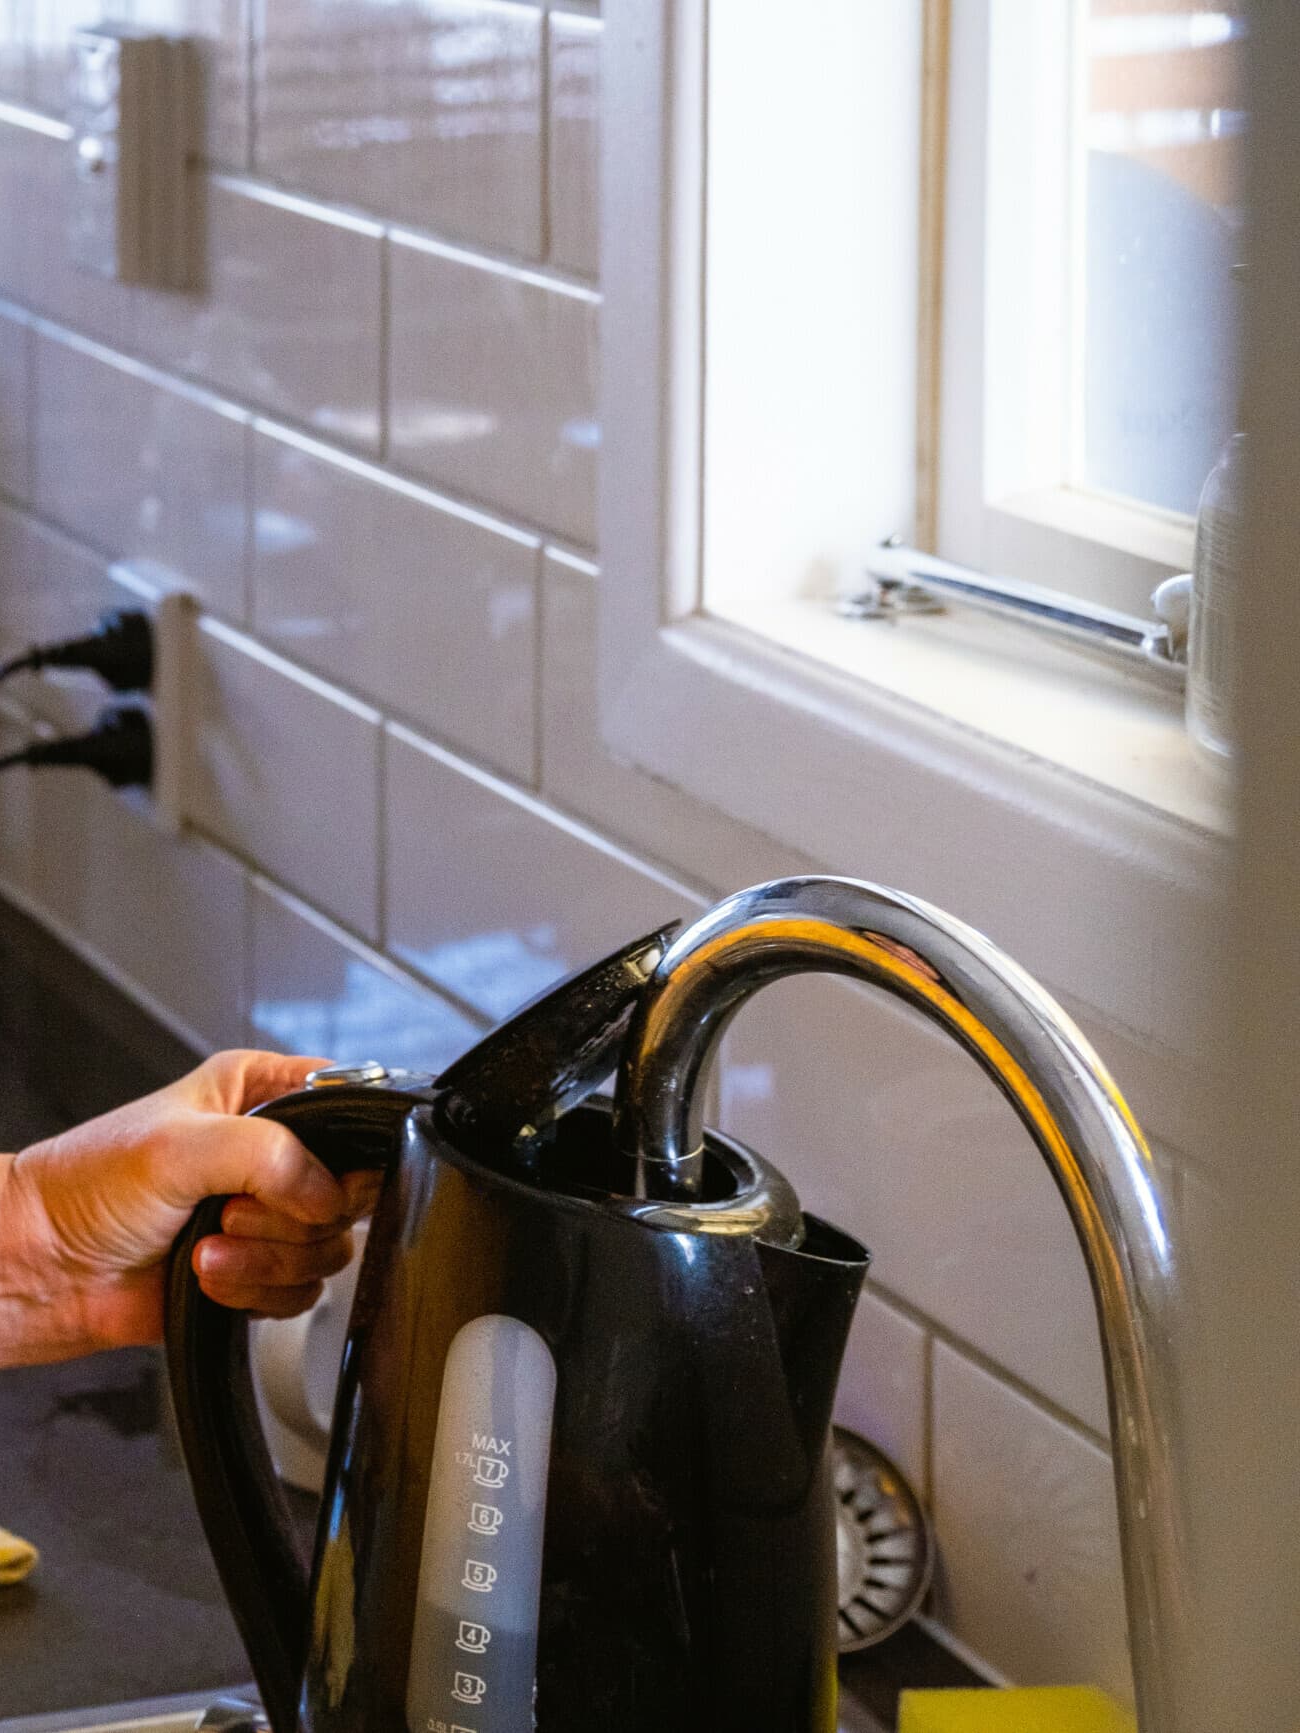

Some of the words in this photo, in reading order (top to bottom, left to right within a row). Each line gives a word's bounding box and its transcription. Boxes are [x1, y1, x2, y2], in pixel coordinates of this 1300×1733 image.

[471, 1433, 512, 1457] MAX
[485, 1462, 496, 1478] 7
[479, 1509, 489, 1526] 6
[473, 1566, 484, 1583] 5
[465, 1628, 477, 1644] 4
[462, 1678, 472, 1694] 3
